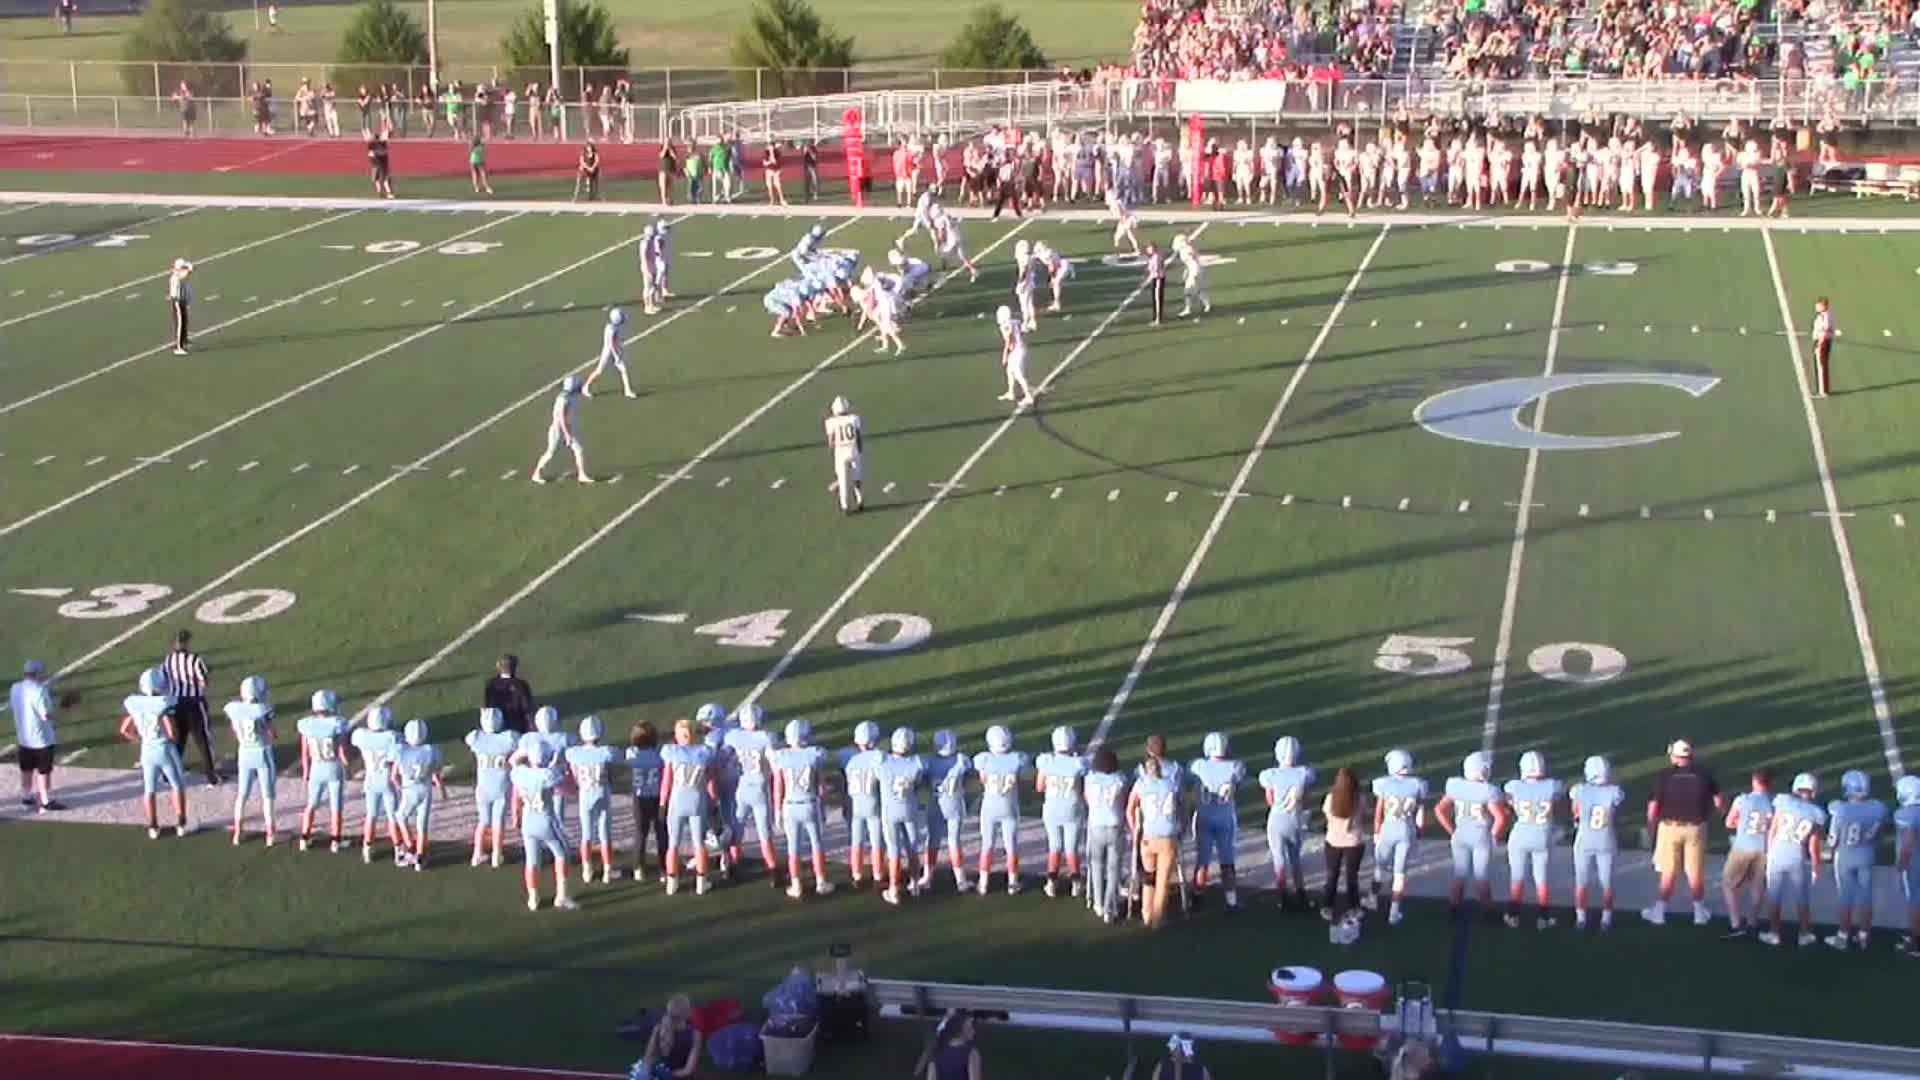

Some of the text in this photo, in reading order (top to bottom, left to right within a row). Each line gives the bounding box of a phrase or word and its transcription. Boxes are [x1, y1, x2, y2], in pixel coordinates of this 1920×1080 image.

[838, 421, 855, 442] 10
[1413, 373, 1722, 450] C
[57, 583, 297, 624] 30
[694, 609, 933, 651] 40
[1373, 634, 1628, 683] 50
[1589, 805, 1608, 829] 8
